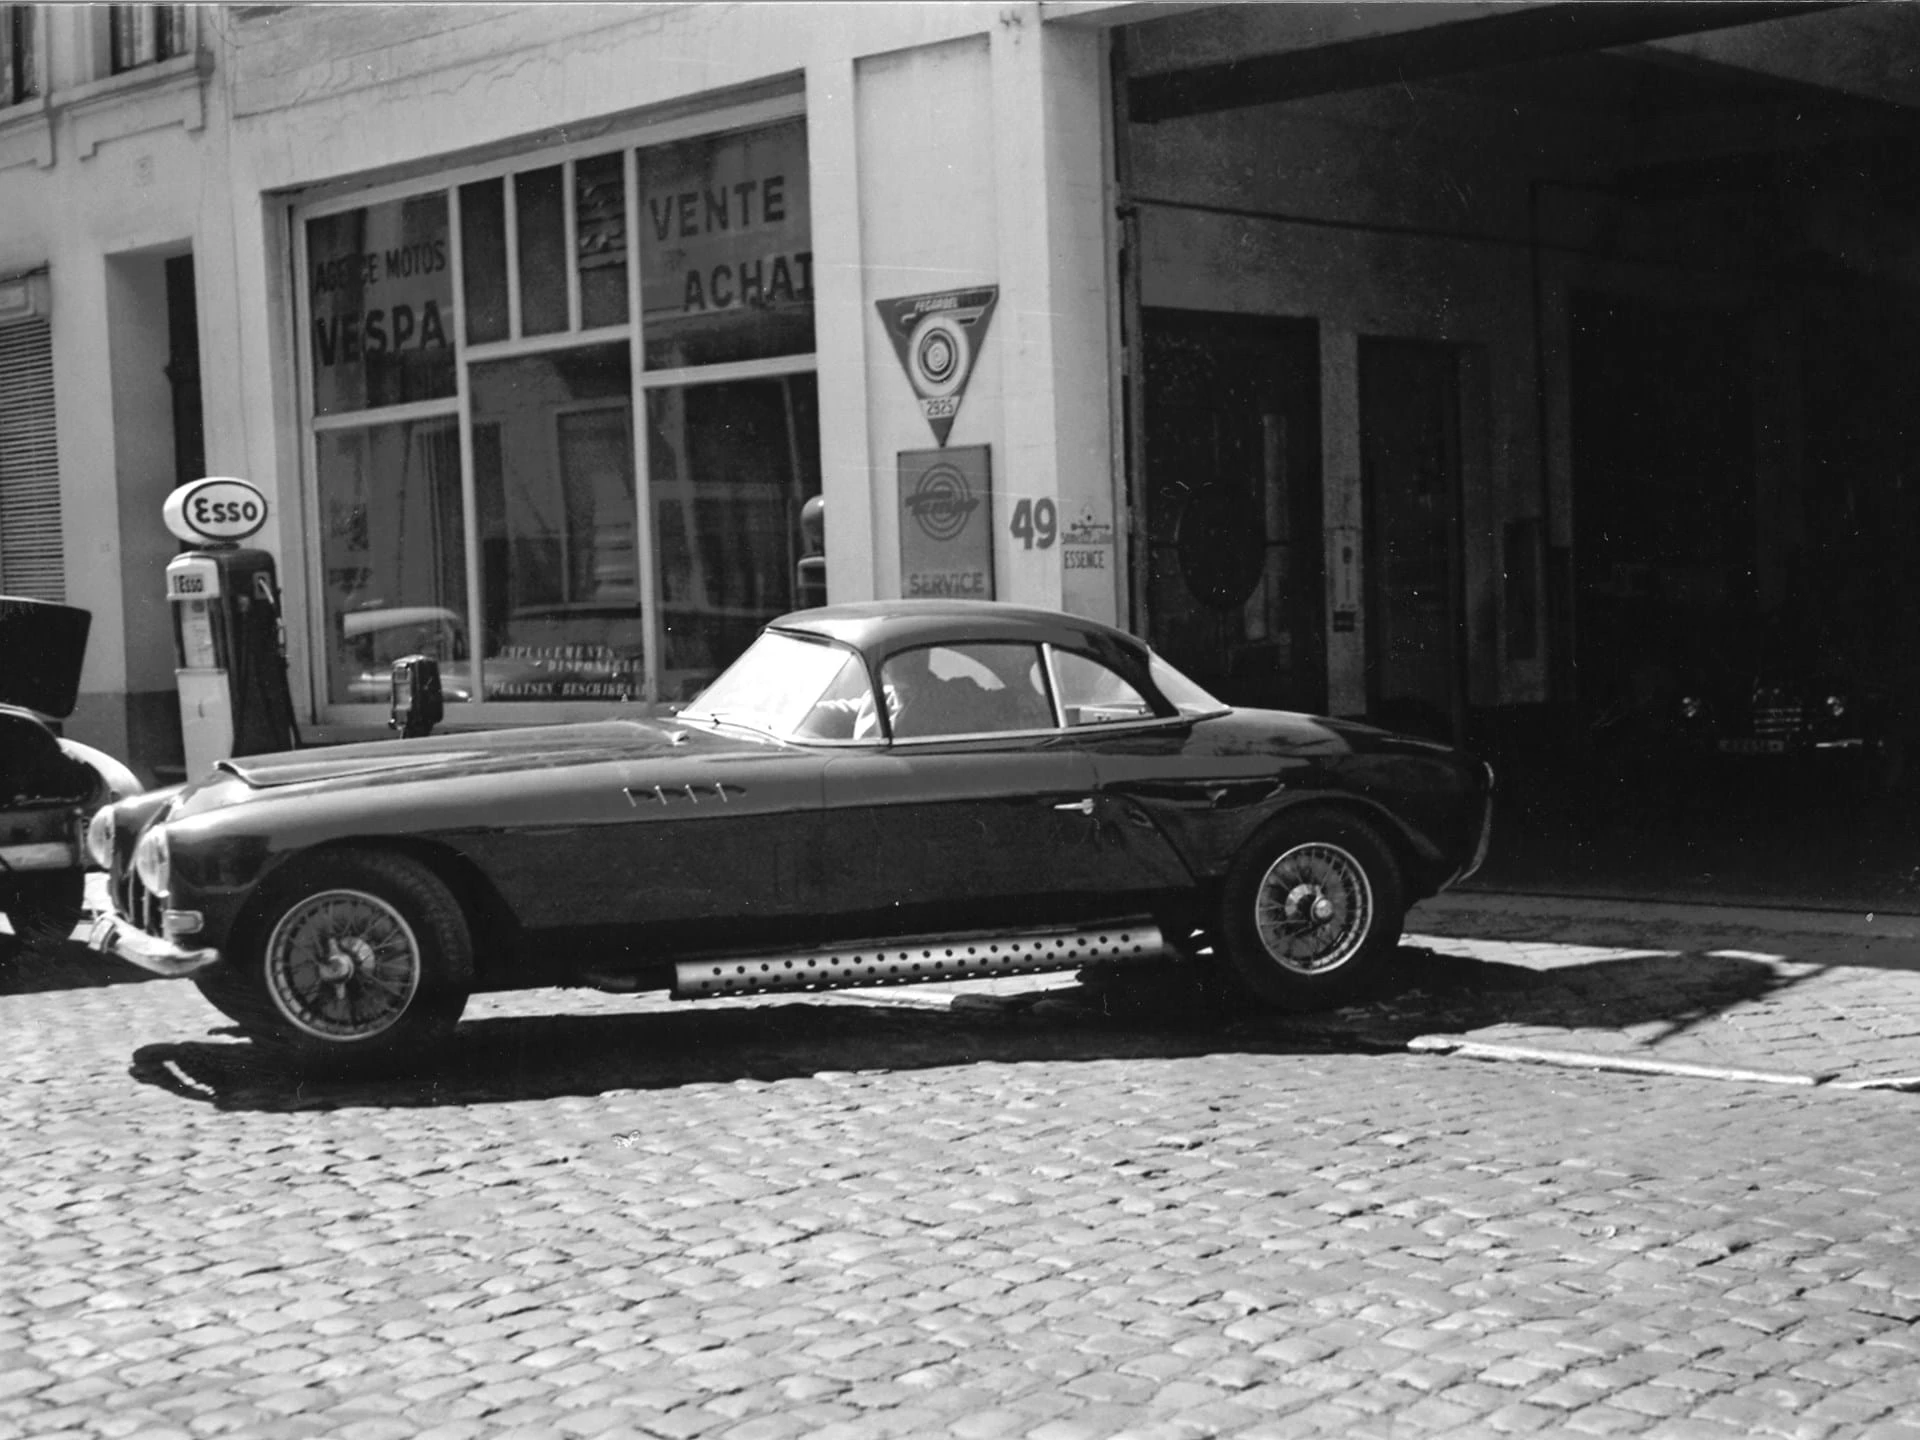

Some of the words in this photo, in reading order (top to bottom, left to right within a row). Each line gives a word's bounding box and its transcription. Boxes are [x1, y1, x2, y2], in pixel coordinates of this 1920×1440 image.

[649, 174, 787, 242] VENTE
[385, 239, 447, 281] MOTOS
[315, 300, 448, 366] VESPA
[1009, 497, 1058, 550] 49
[1063, 549, 1105, 570] ESSENCE
[909, 571, 985, 596] SERVICE
